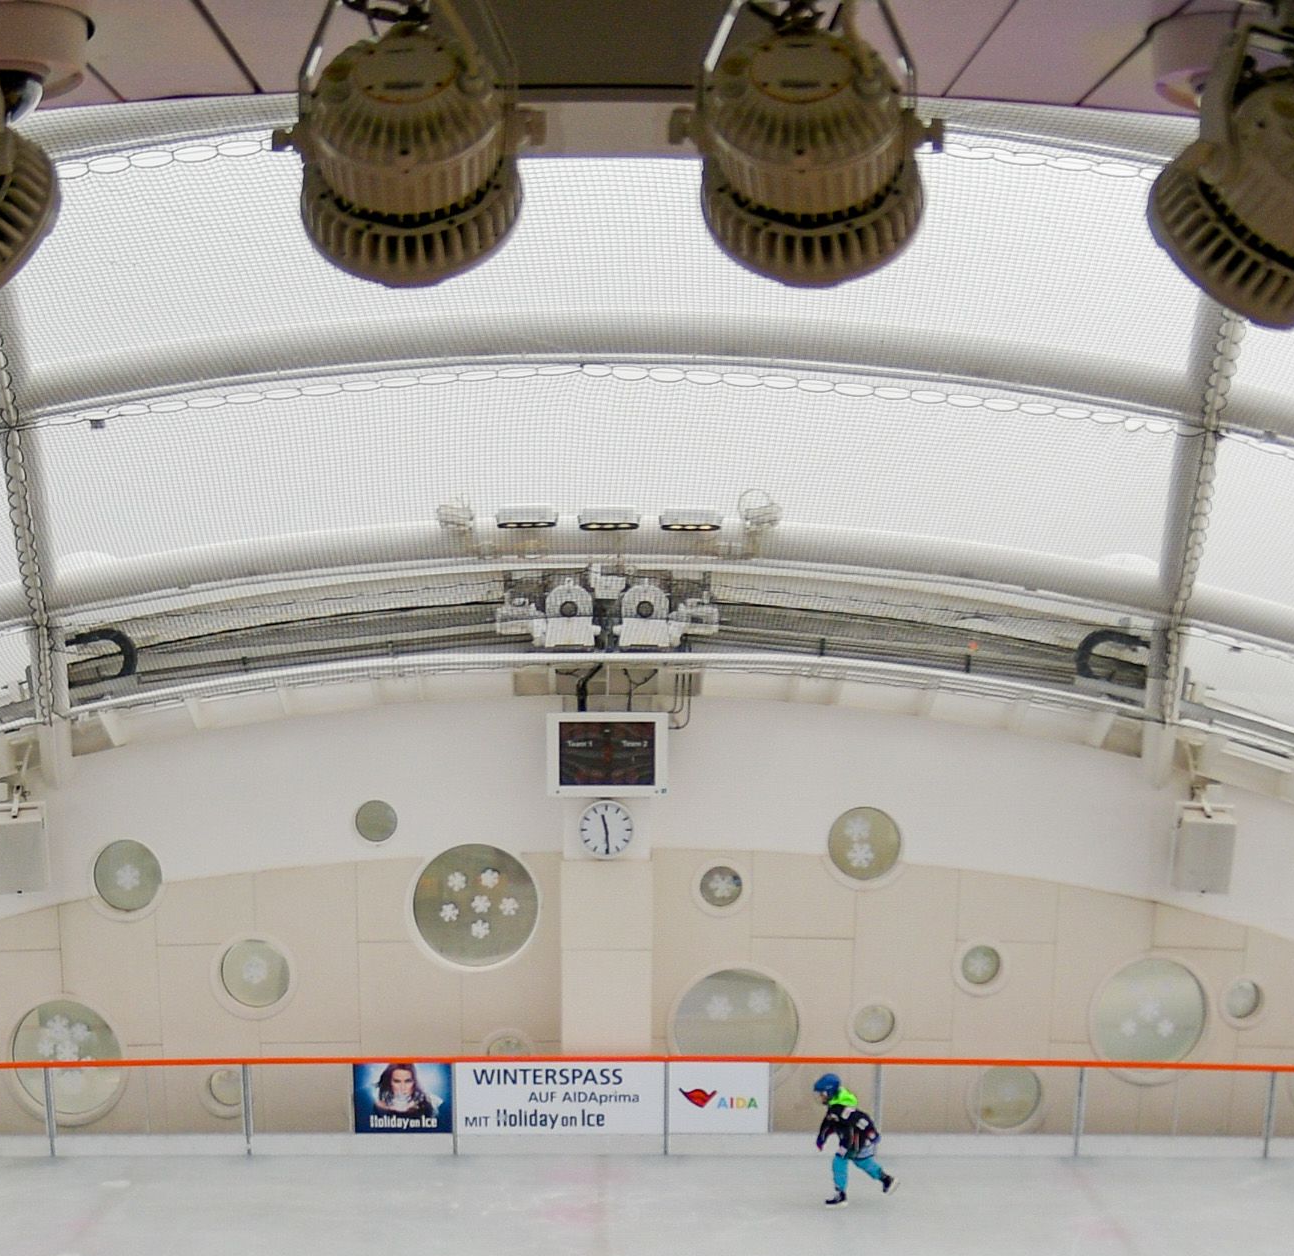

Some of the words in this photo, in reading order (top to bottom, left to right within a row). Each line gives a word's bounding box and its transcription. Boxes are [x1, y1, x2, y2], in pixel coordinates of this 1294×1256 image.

[473, 1068, 623, 1085] WINTERSPASS
[528, 1092, 557, 1103] AUF
[562, 1091, 640, 1106] AIDAprima
[716, 1096, 759, 1109] AIDA
[370, 1114, 409, 1130] Holiday
[409, 1119, 421, 1128] on
[421, 1114, 438, 1128] Ice
[464, 1116, 490, 1127] MIT
[496, 1109, 559, 1129] Holiday
[561, 1115, 577, 1127] on
[581, 1109, 605, 1127] Ice
